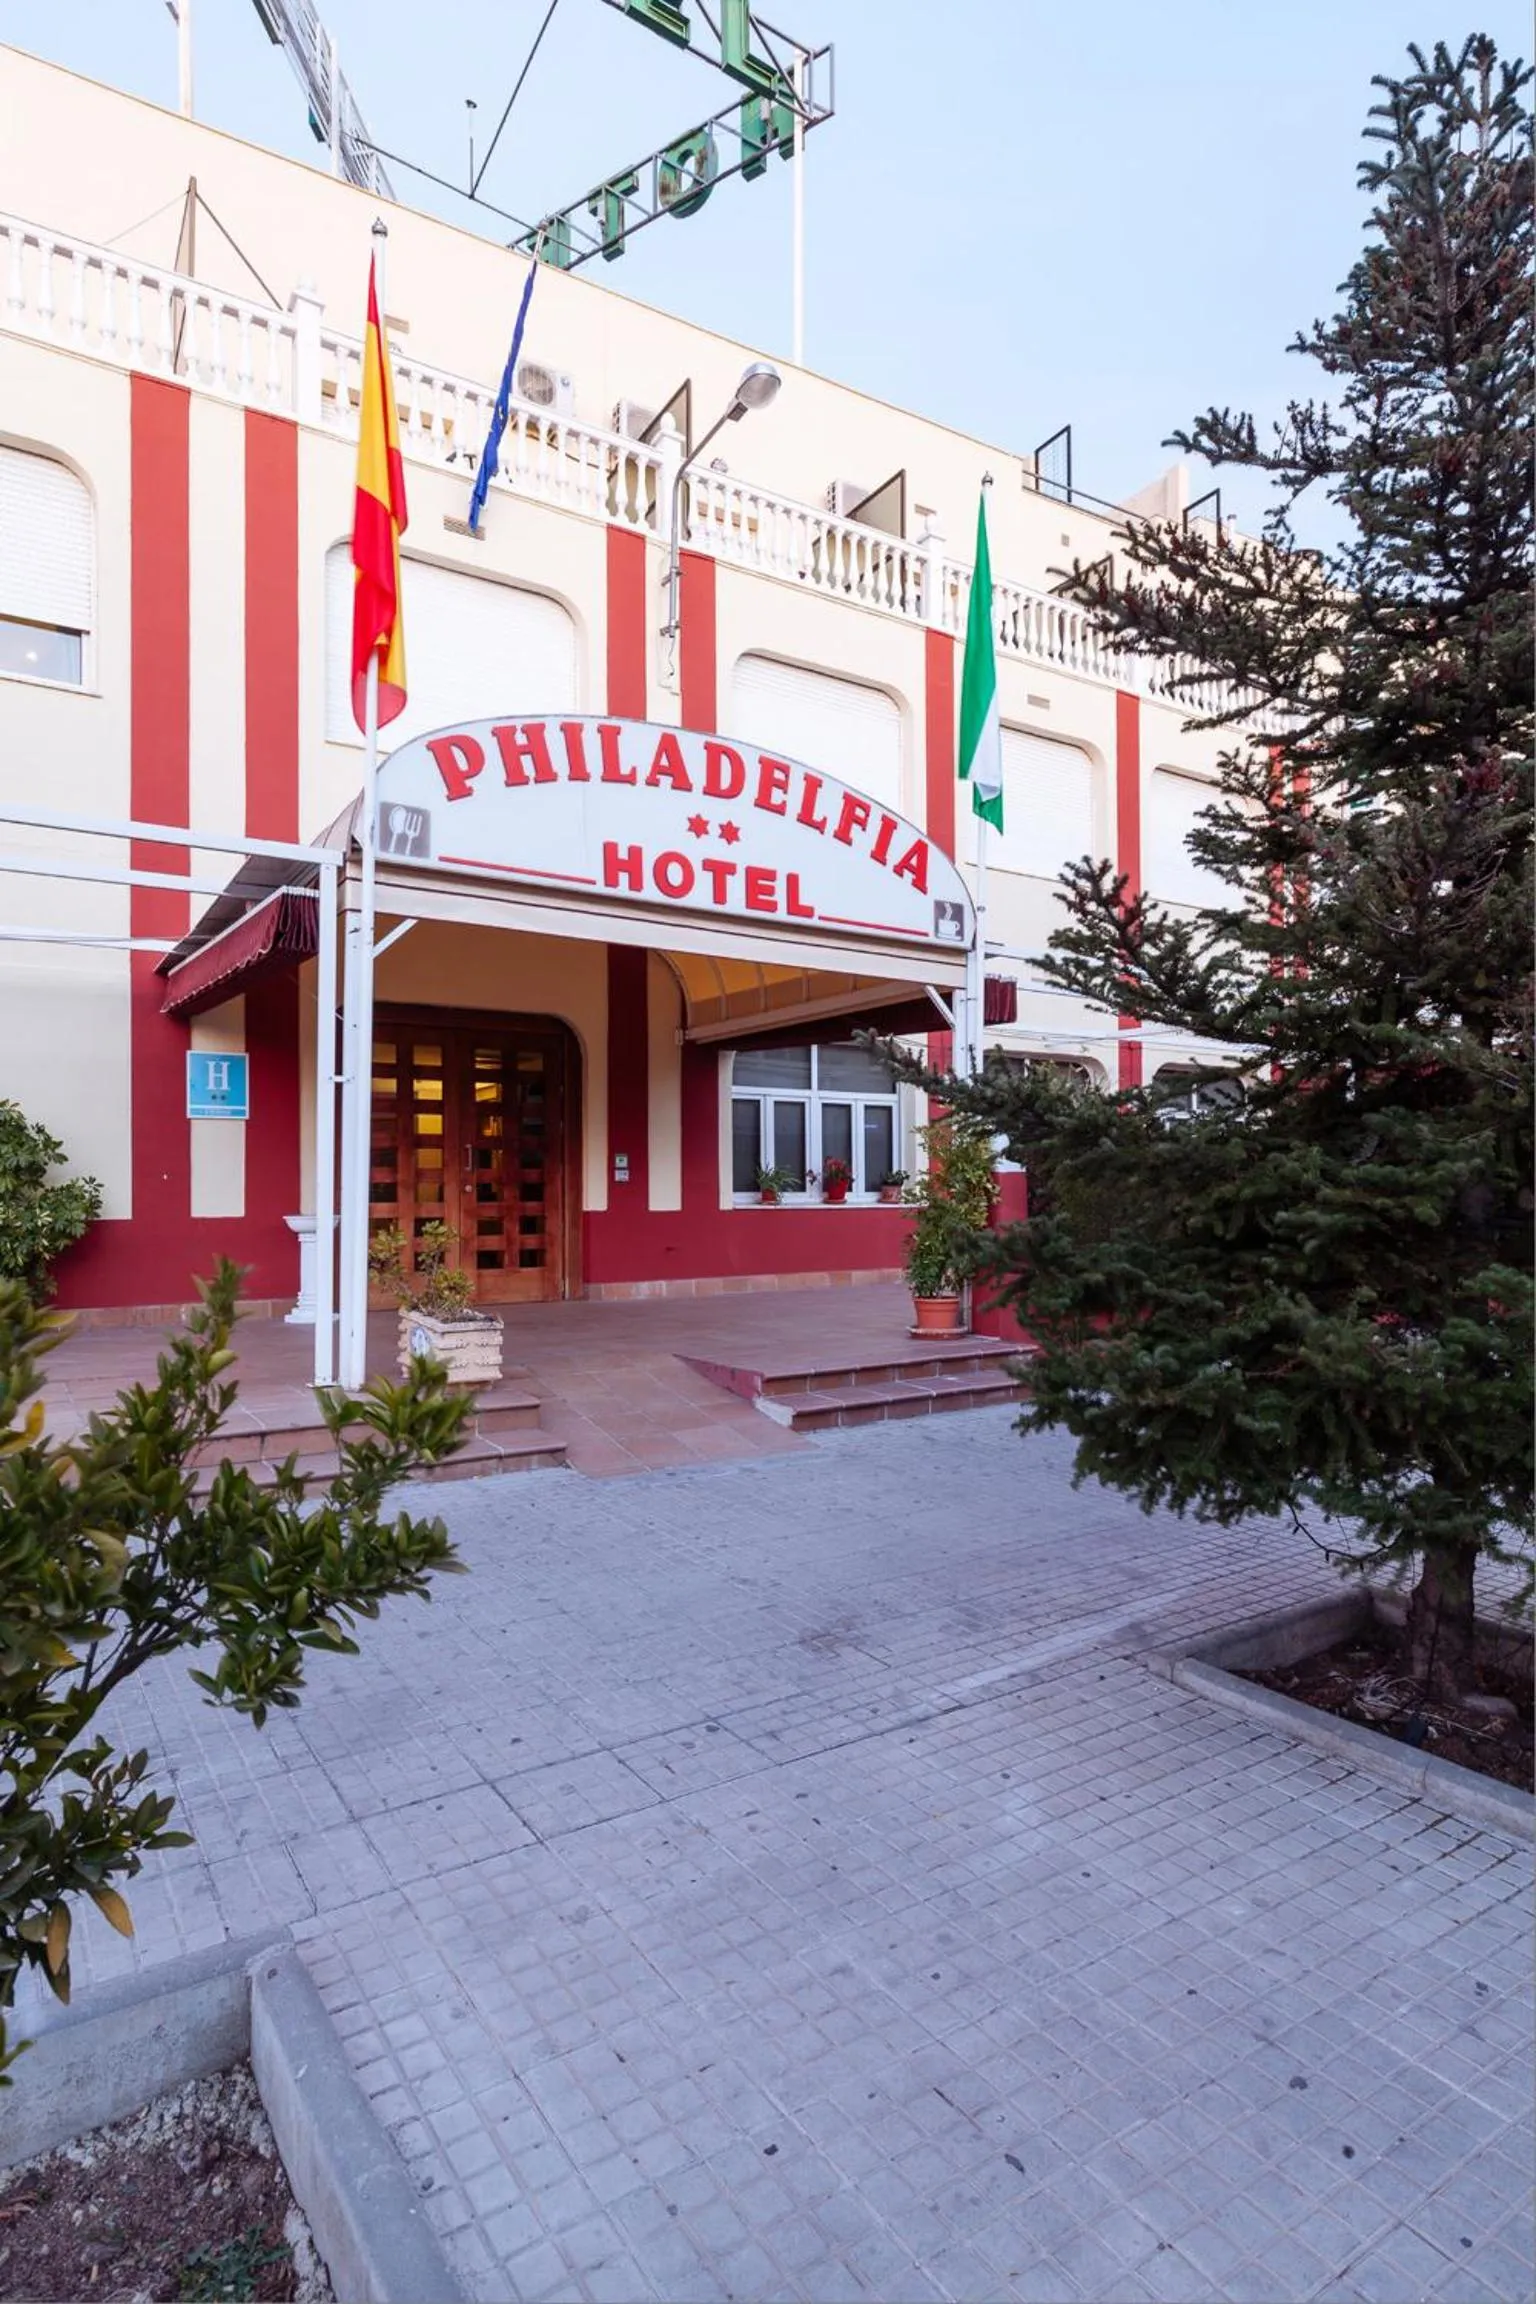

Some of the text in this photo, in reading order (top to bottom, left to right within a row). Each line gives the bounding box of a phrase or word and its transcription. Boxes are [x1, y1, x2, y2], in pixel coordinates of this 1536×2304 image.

[426, 720, 929, 895] PHILADELFIA
[603, 841, 815, 918] HOTEL
[206, 1060, 230, 1090] H
